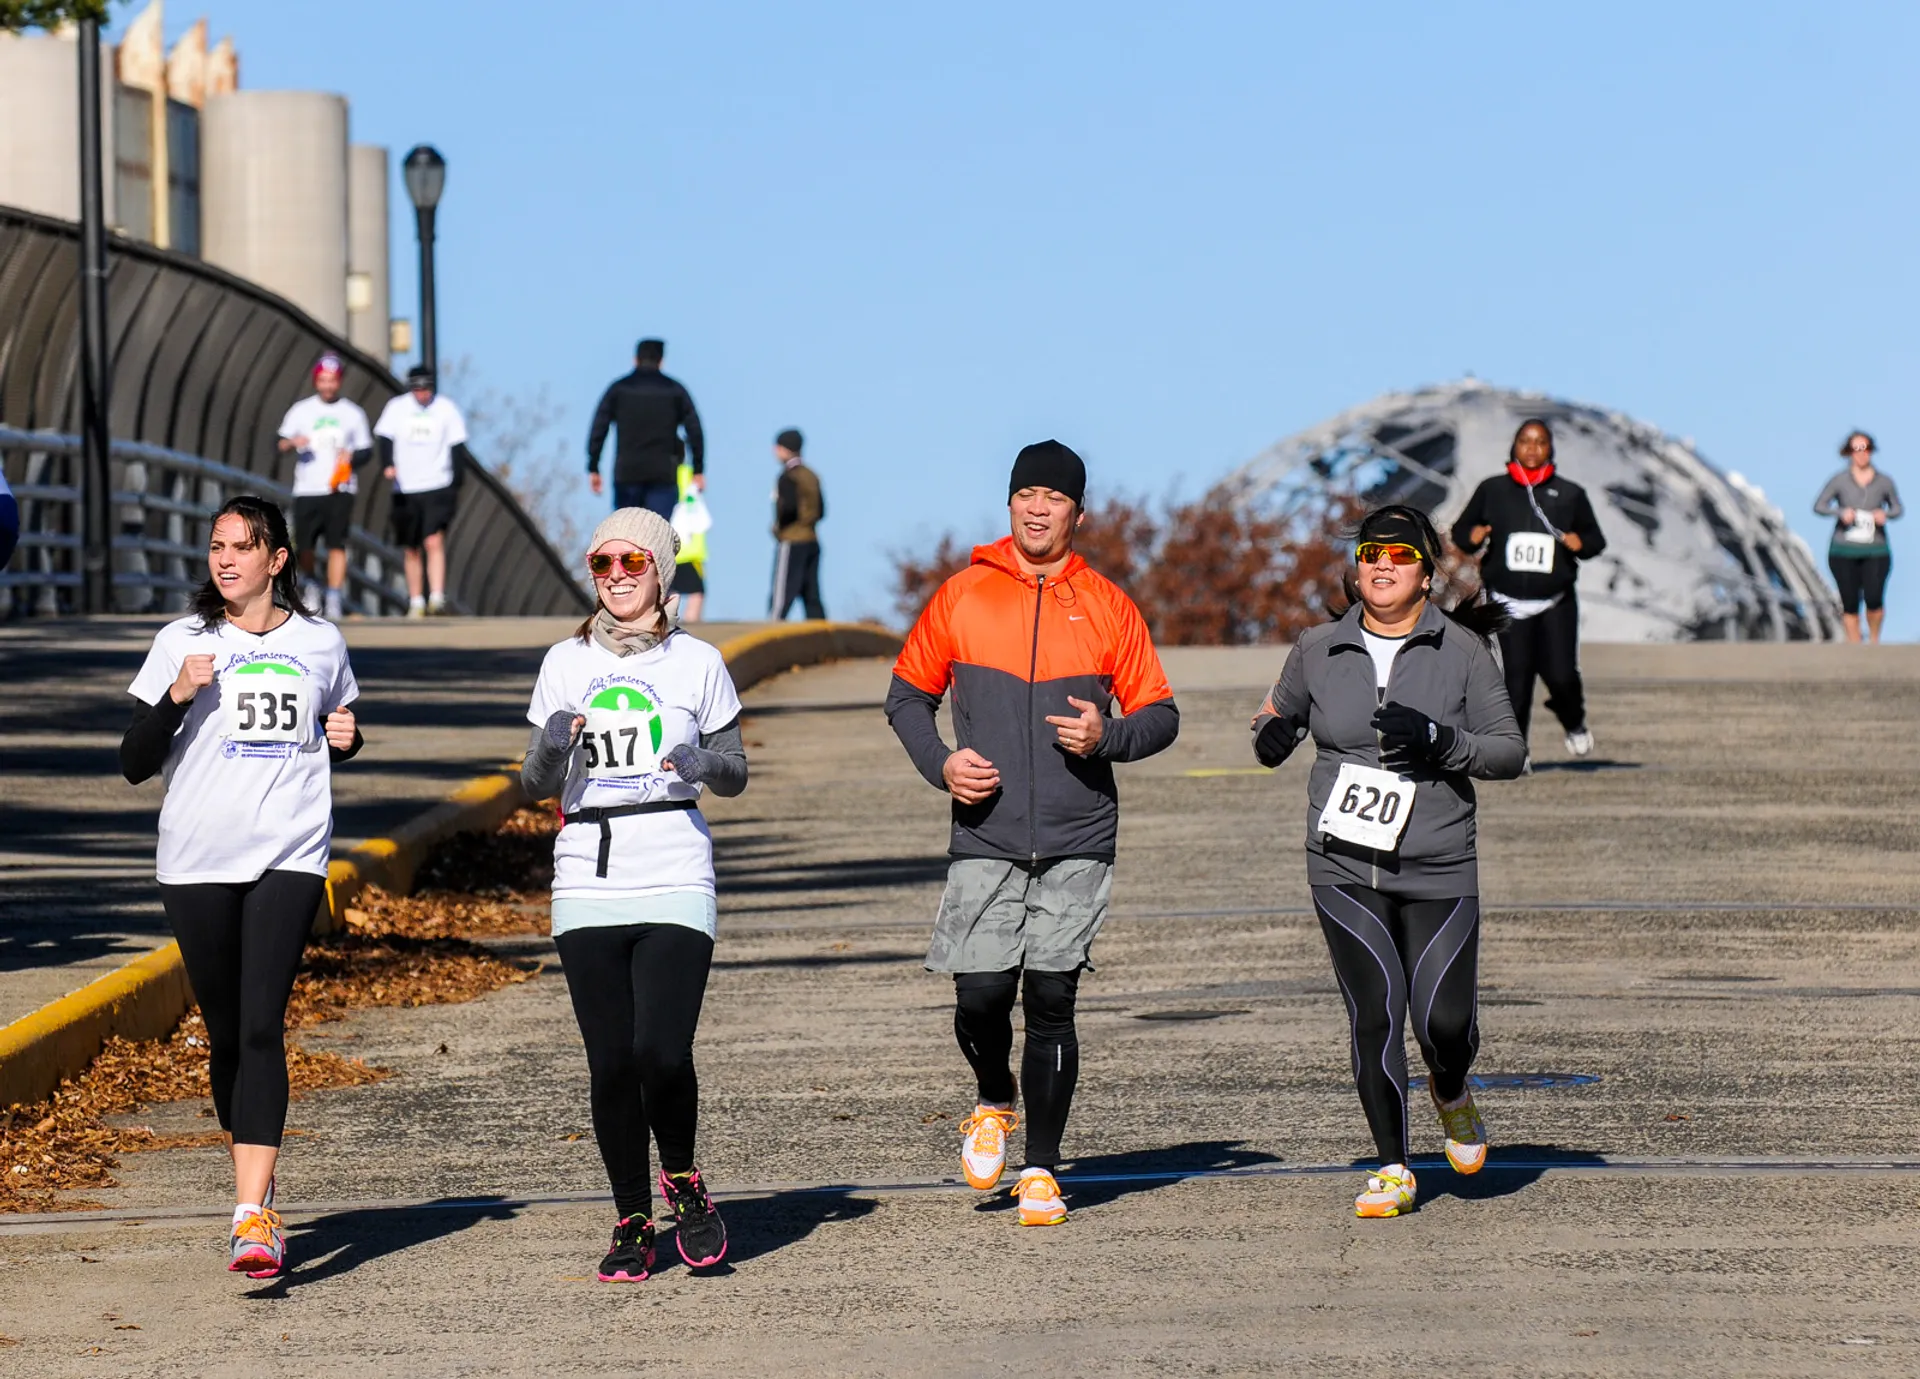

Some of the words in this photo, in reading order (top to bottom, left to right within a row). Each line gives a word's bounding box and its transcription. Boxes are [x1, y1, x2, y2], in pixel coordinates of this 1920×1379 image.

[1514, 544, 1544, 565] 601
[237, 692, 298, 731] 535
[582, 727, 638, 769] 517
[1339, 783, 1401, 825] 620
